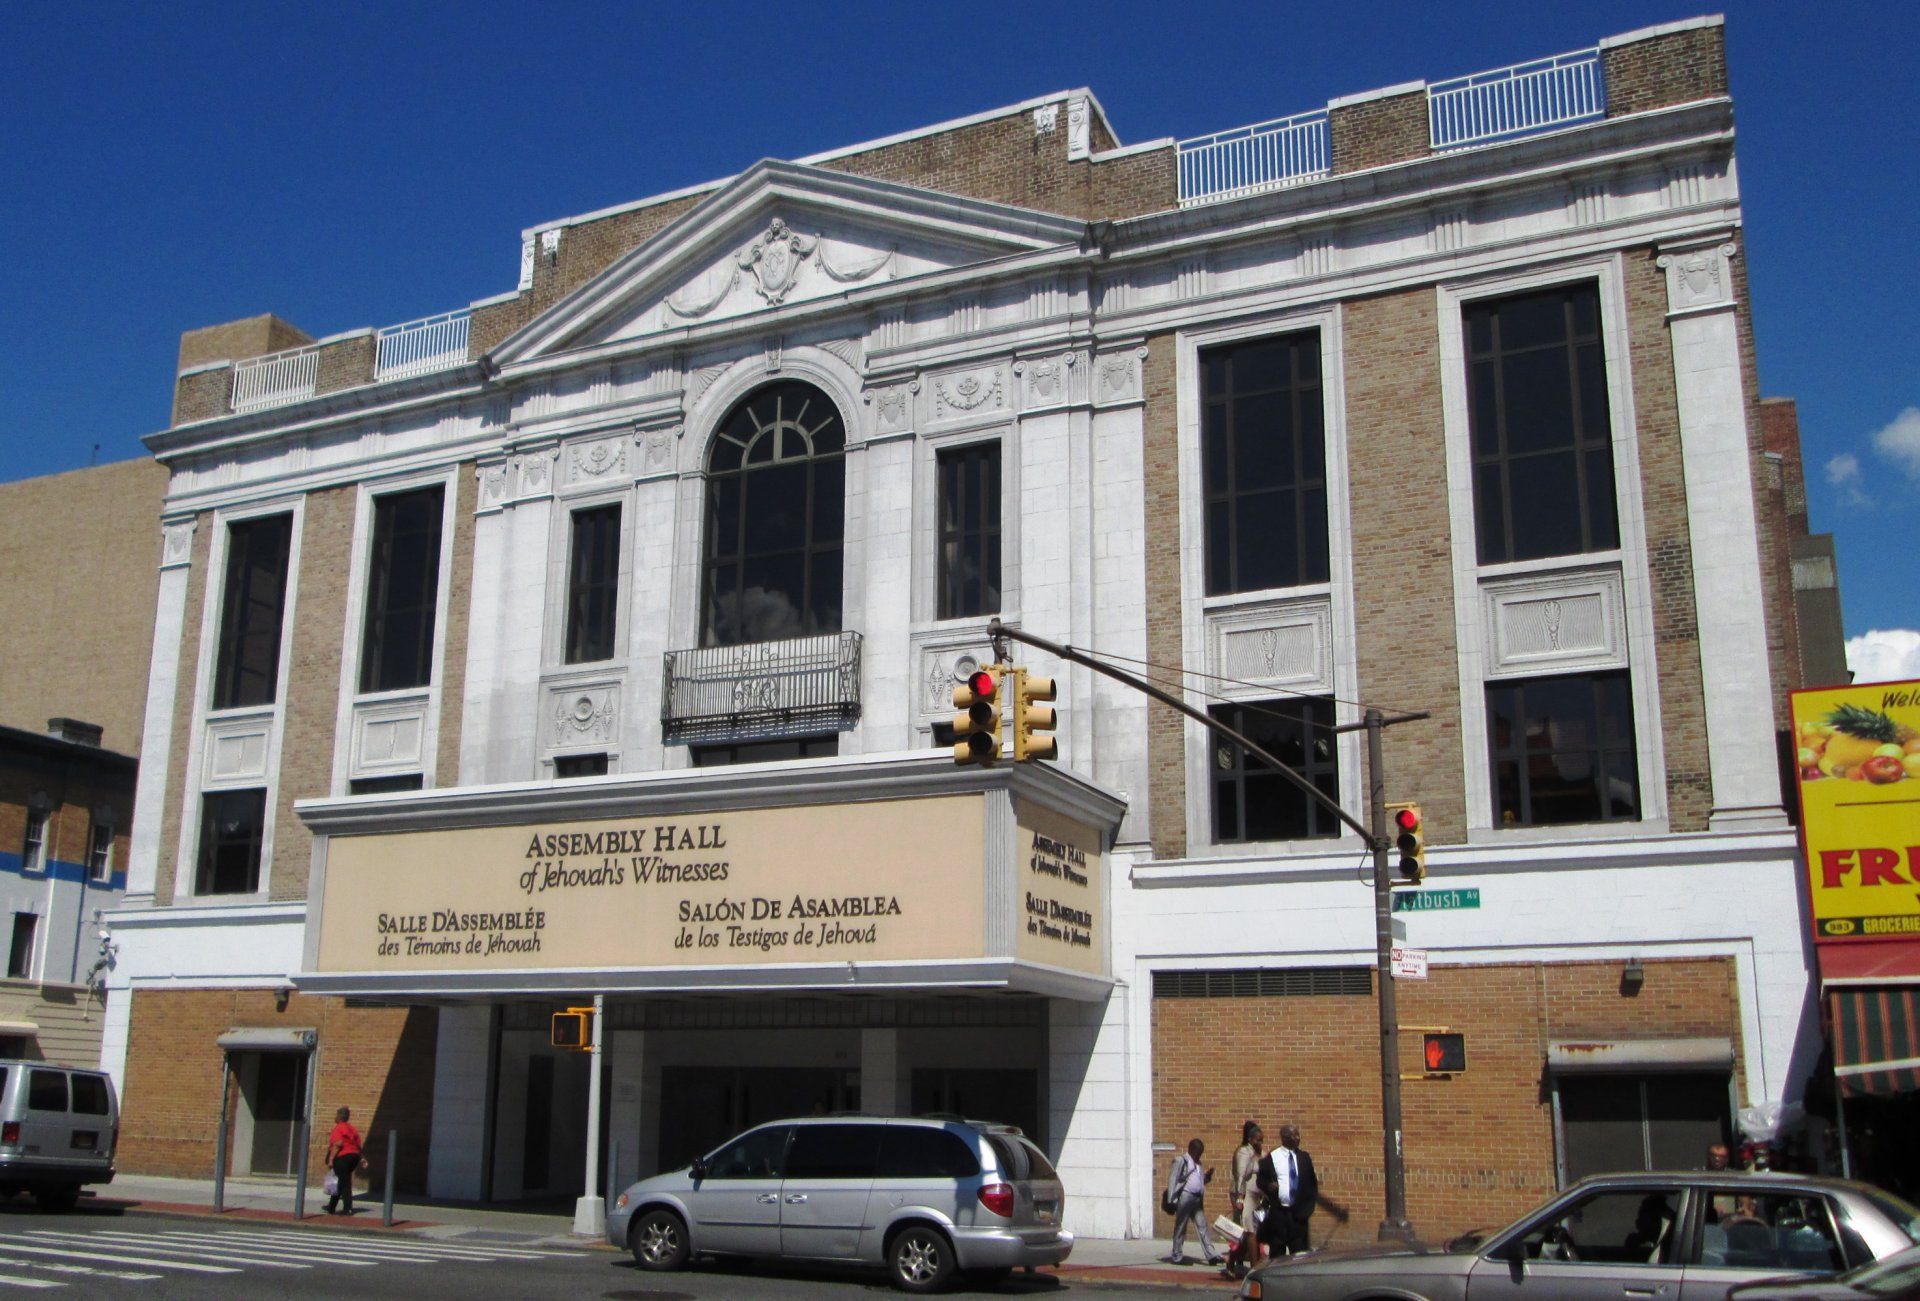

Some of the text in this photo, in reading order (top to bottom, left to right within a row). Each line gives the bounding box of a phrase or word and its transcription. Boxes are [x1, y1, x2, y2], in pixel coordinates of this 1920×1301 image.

[526, 825, 727, 858] ASSEMBLY HALL
[520, 856, 729, 894] of Jehovah's Witnesses
[377, 906, 546, 934] SALLE D'ASSEMBLÉE
[678, 894, 902, 922] SALÓN DE ASAMBLEA
[378, 931, 541, 957] des Témoins de Jéhovah
[674, 921, 877, 951] de los Testigos de Jehová
[1392, 950, 1402, 960] NO
